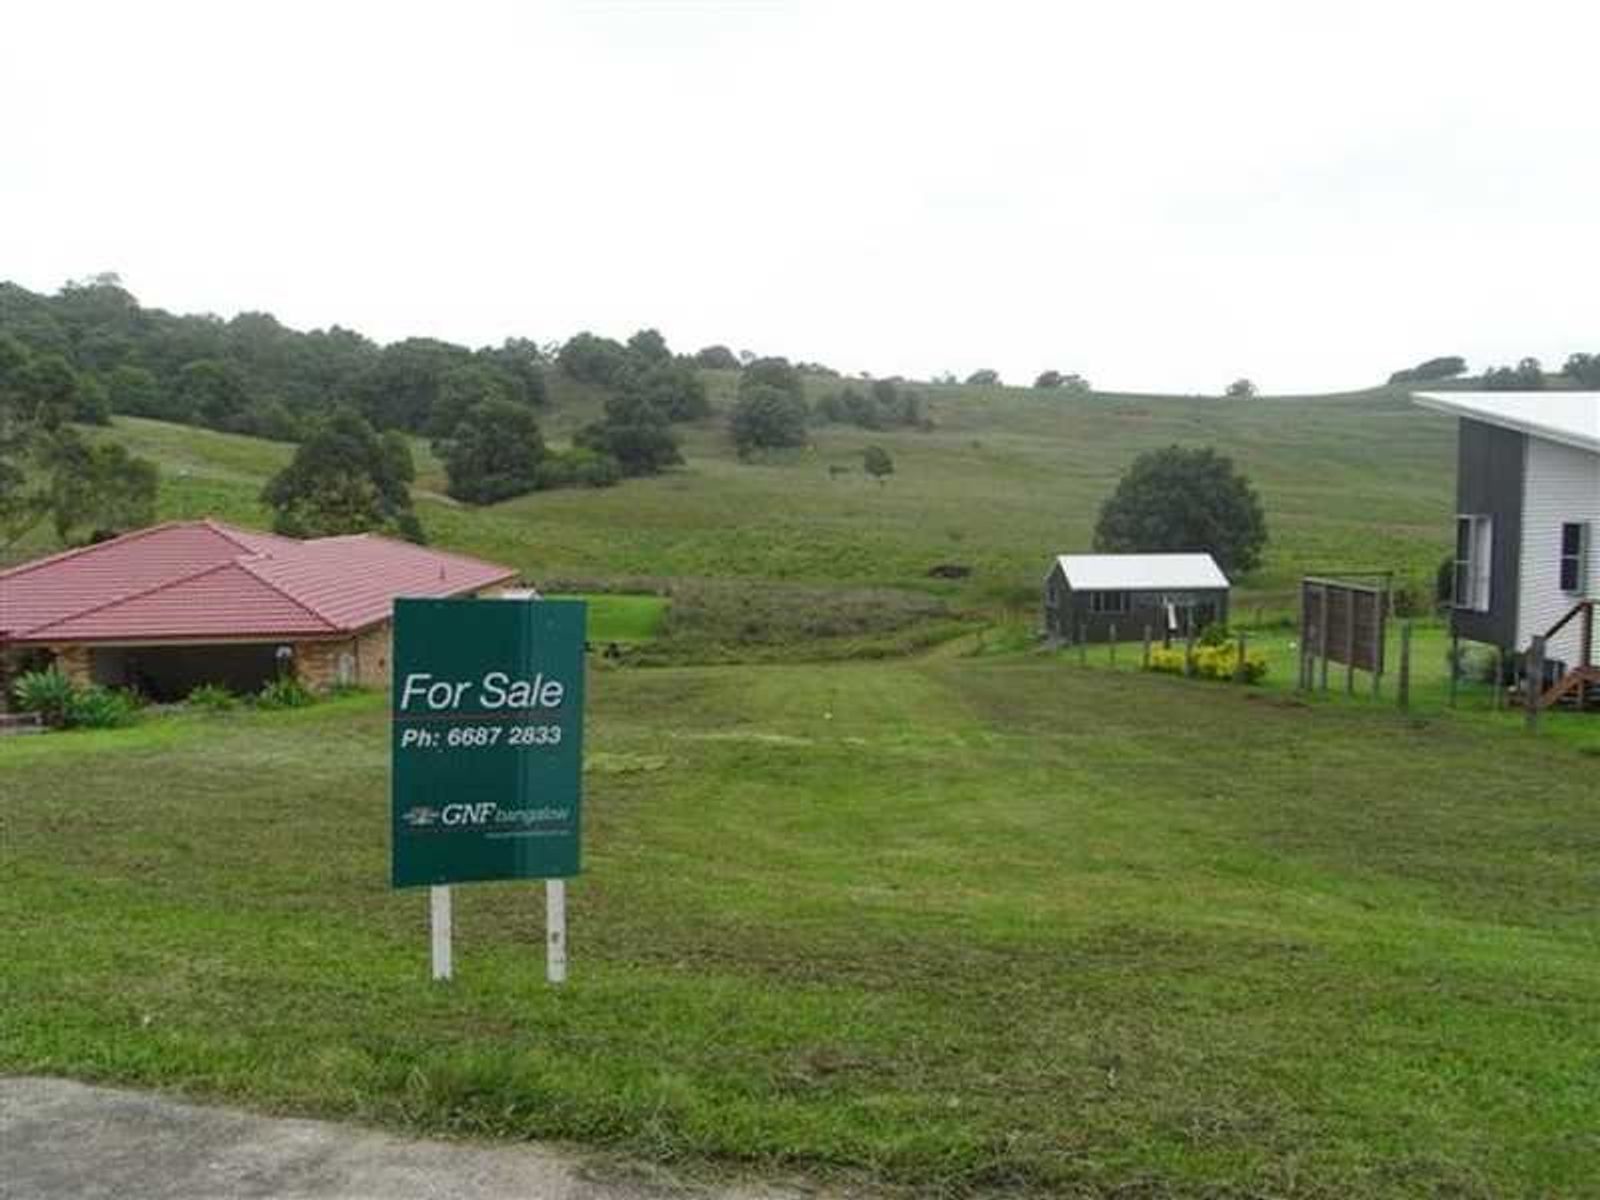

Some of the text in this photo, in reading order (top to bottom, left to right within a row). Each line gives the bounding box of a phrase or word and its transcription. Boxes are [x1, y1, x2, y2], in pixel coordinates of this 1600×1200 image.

[401, 671, 564, 710] For Sale
[401, 725, 562, 748] Ph: 6687 2833
[441, 802, 497, 825] GNF
